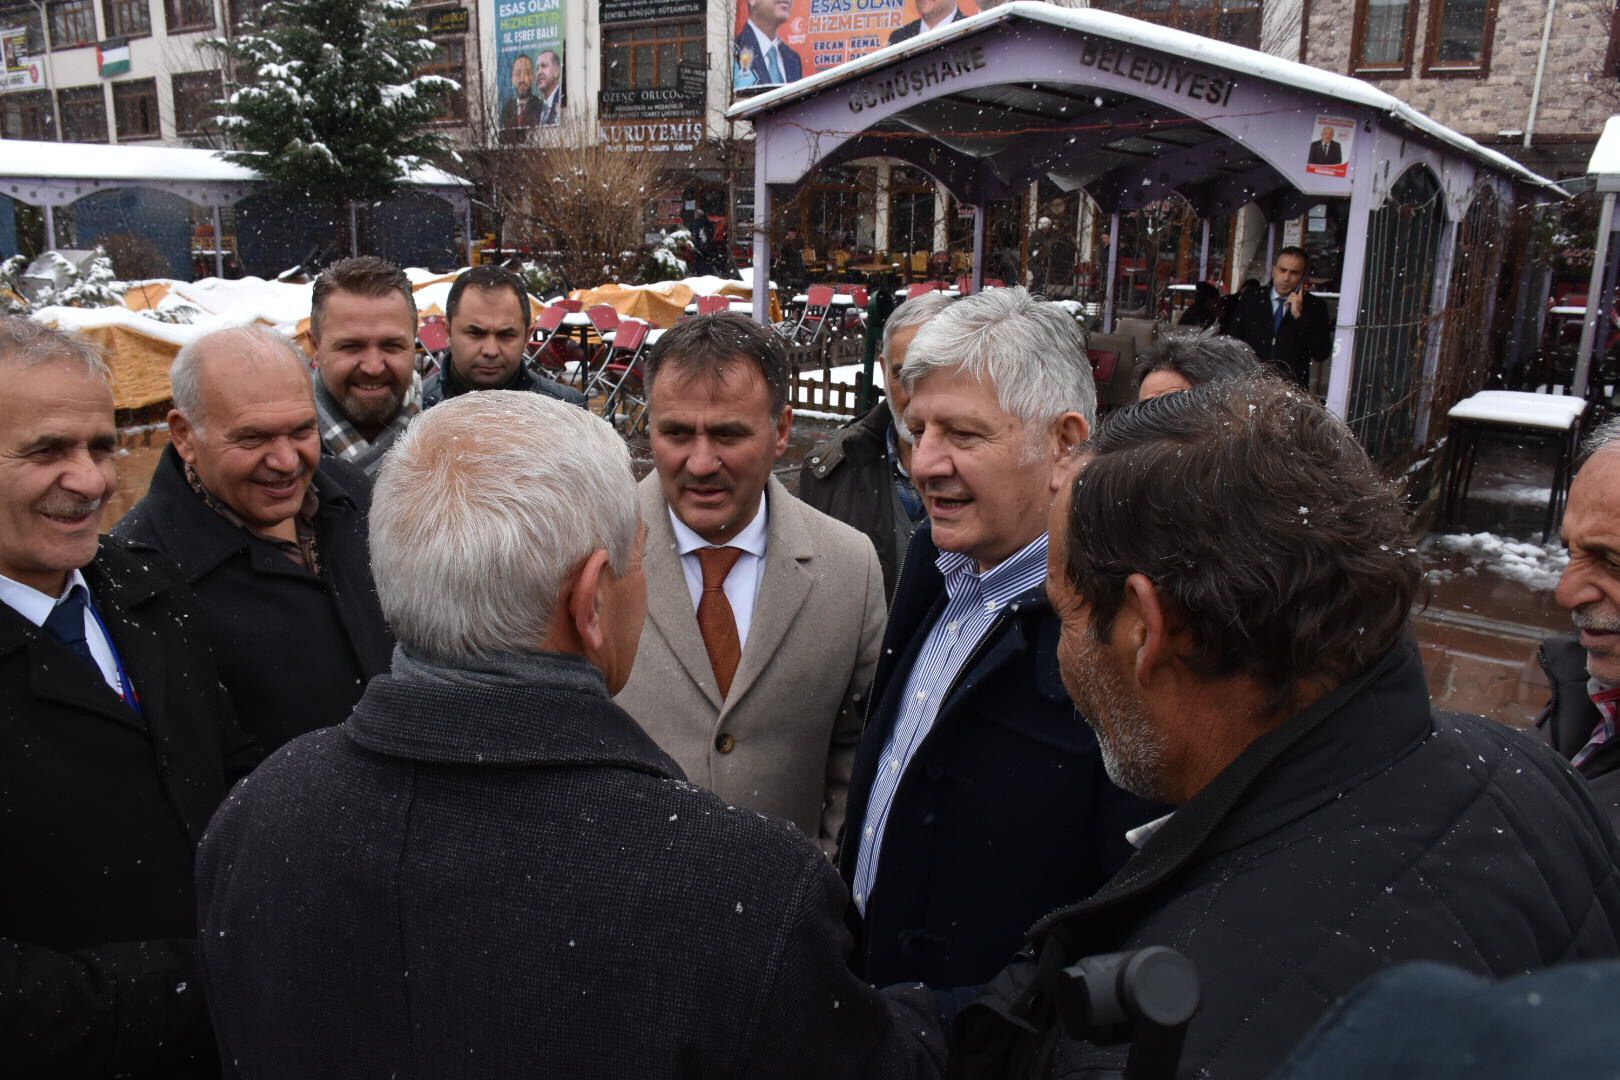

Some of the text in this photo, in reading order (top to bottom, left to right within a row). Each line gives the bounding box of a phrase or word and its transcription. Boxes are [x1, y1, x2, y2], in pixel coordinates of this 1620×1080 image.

[499, 0, 560, 17] ESAS OLAN
[811, 0, 852, 14] ESAS
[814, 40, 844, 51] ERCAN
[851, 38, 881, 49] KEMAL
[849, 46, 986, 114] GÜMÜŞHANE
[1079, 42, 1235, 108] BELEDİYESİ
[599, 119, 702, 146] KURUYEMİŞ
